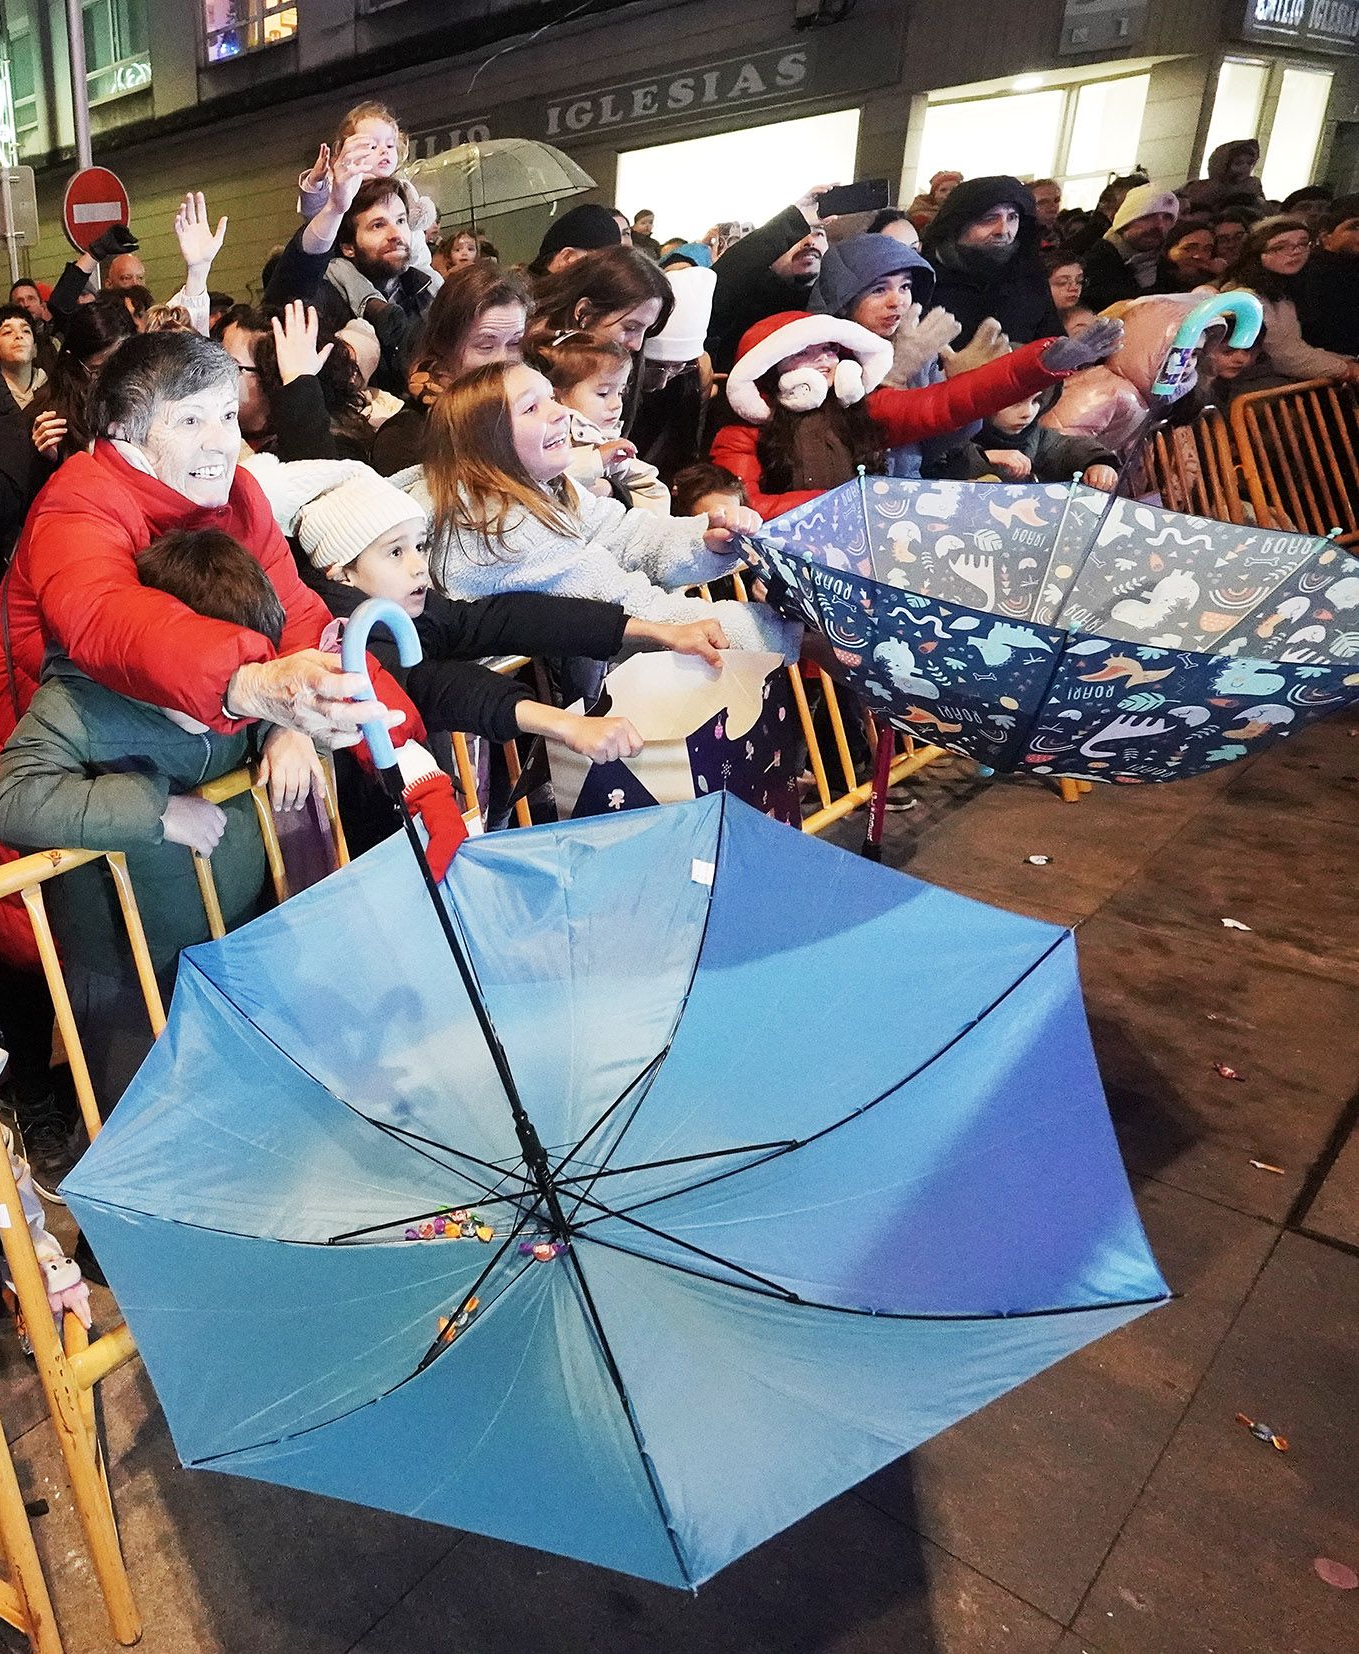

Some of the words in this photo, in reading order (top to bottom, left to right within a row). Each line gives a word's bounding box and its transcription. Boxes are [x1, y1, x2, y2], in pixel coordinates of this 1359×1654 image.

[545, 52, 807, 135] IGLESIAS
[1067, 684, 1115, 700] ROAR!
[937, 704, 983, 724] ROAR!
